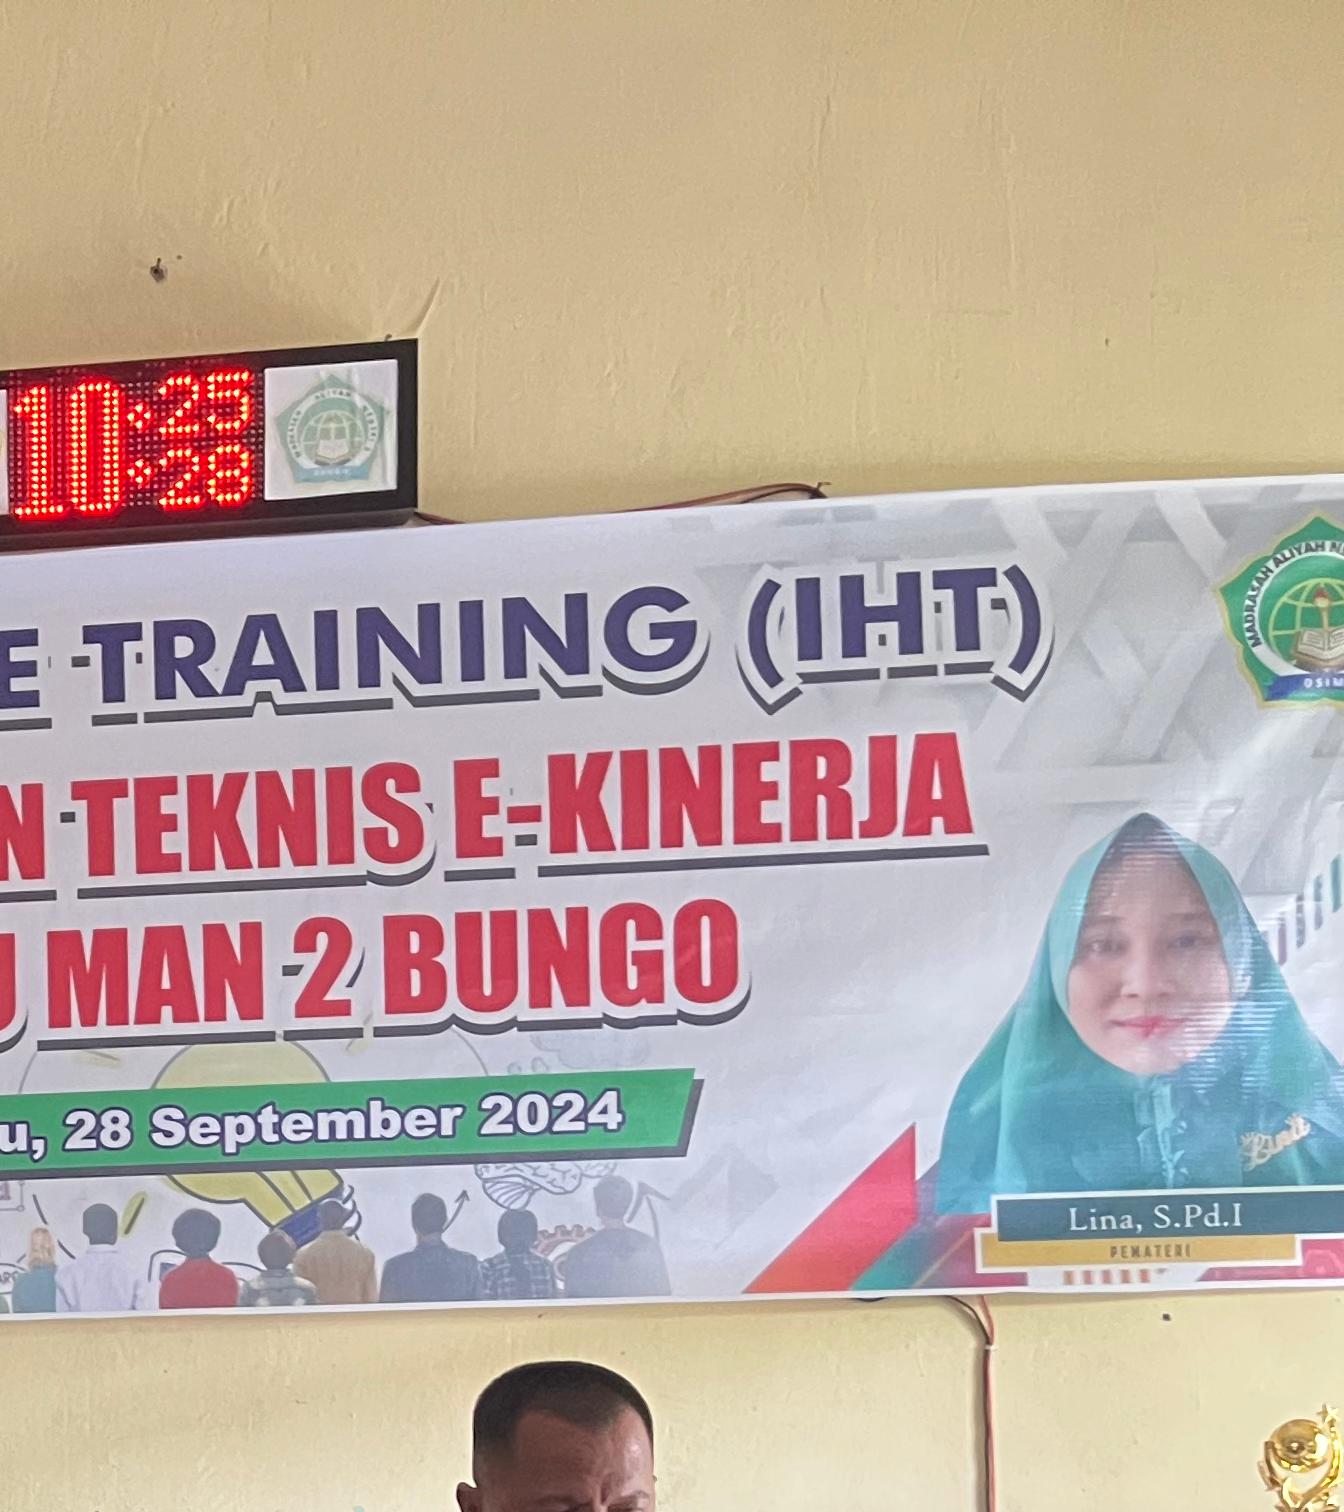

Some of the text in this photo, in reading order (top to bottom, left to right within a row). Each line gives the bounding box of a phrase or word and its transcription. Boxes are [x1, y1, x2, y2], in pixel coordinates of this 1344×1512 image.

[80, 587, 698, 706] TRAINING
[746, 566, 1048, 698] (IHT)
[69, 760, 426, 878] TEKNIS
[450, 731, 975, 862] E-KINERJA
[44, 920, 266, 1030] MAN
[291, 914, 356, 1019] 2
[381, 897, 741, 1016] BUNGO
[62, 1108, 134, 1151] 28
[150, 1098, 465, 1155] September
[478, 1089, 624, 1136] 2024
[1069, 1203, 1242, 1235] Lina, S.Pd.I
[1109, 1243, 1191, 1259] PEMATERI
